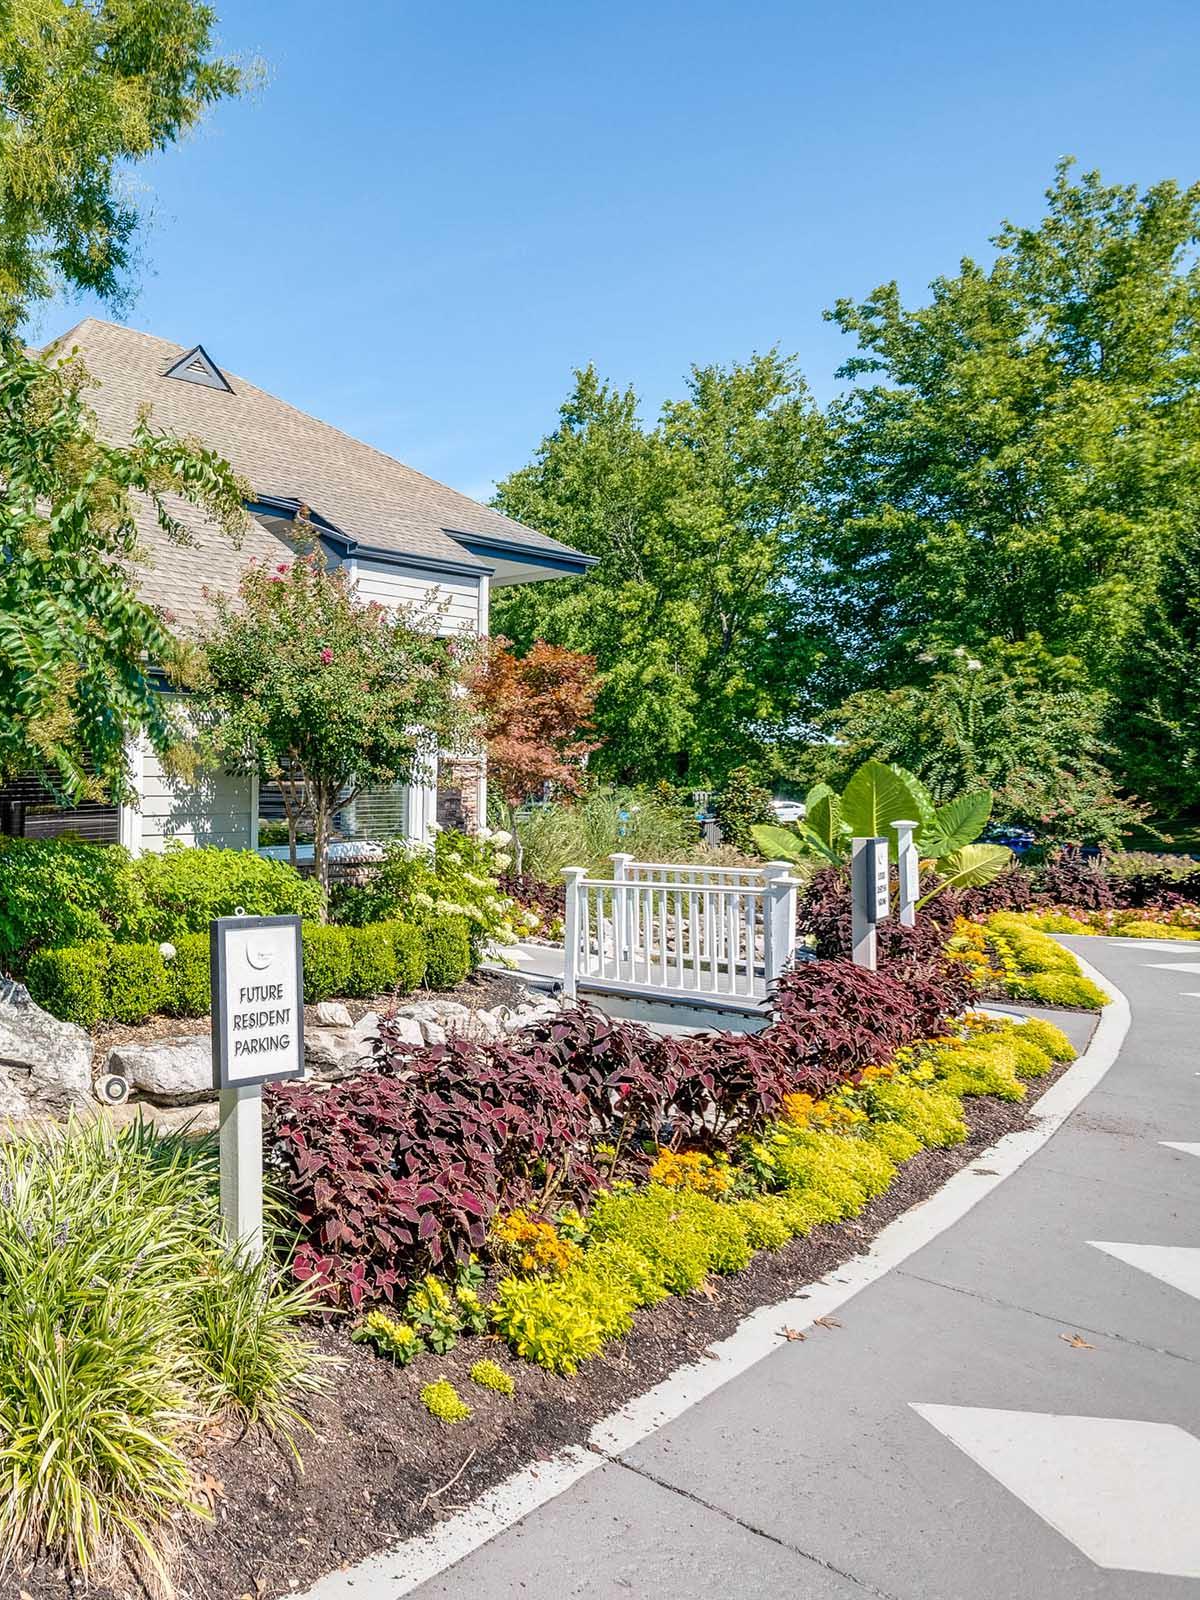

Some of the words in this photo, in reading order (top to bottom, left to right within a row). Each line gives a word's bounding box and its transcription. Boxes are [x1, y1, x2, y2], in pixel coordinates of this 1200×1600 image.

[240, 984, 283, 1003] FUTURE
[233, 1008, 291, 1031] RESIDENT
[234, 1034, 290, 1056] PARKING
